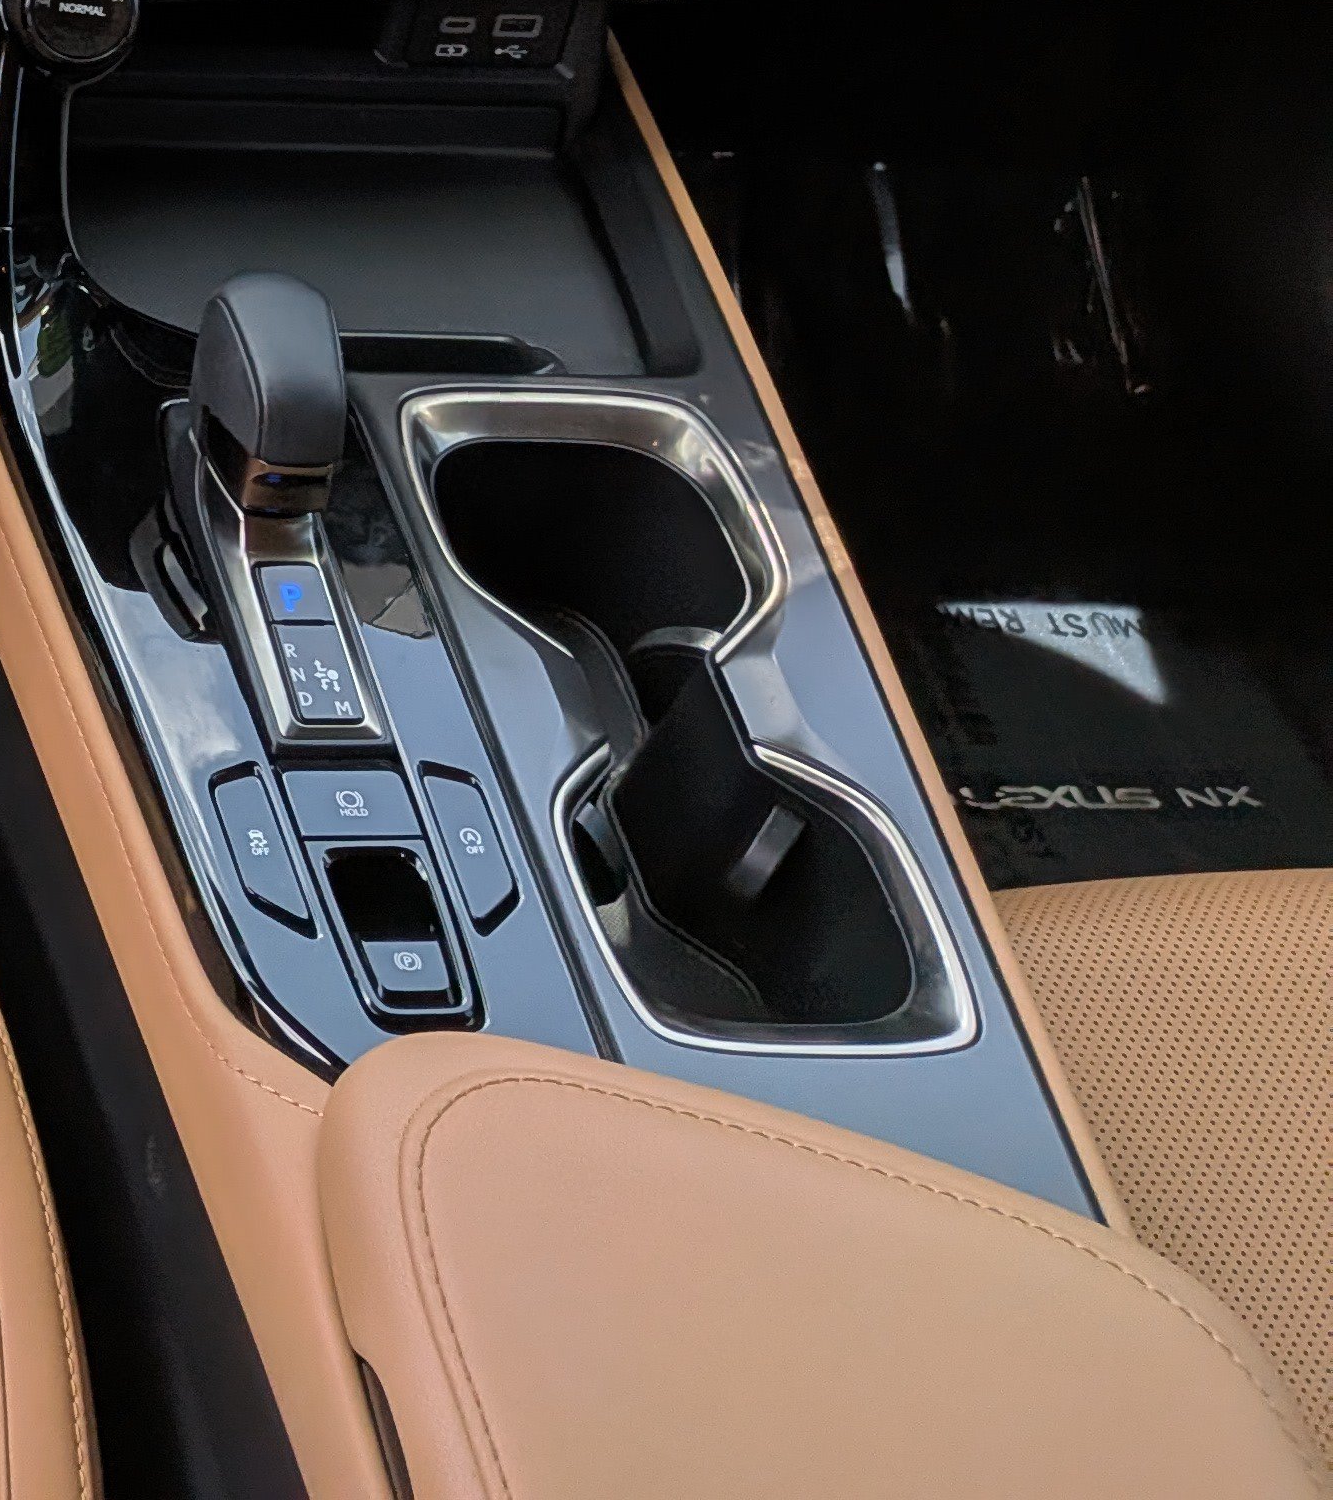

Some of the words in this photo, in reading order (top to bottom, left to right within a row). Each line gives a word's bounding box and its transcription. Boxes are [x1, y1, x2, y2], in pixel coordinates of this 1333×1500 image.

[59, 3, 106, 17] NORMAL
[278, 583, 303, 612] P
[1046, 611, 1142, 639] MUST
[283, 643, 298, 658] R
[289, 667, 307, 683] N
[297, 691, 313, 706] D
[333, 700, 354, 716] M
[958, 784, 1161, 810] LEXUS
[1174, 784, 1264, 809] NX
[339, 807, 369, 817] HOLD
[251, 846, 270, 856] OFF
[466, 844, 485, 855] OFF
